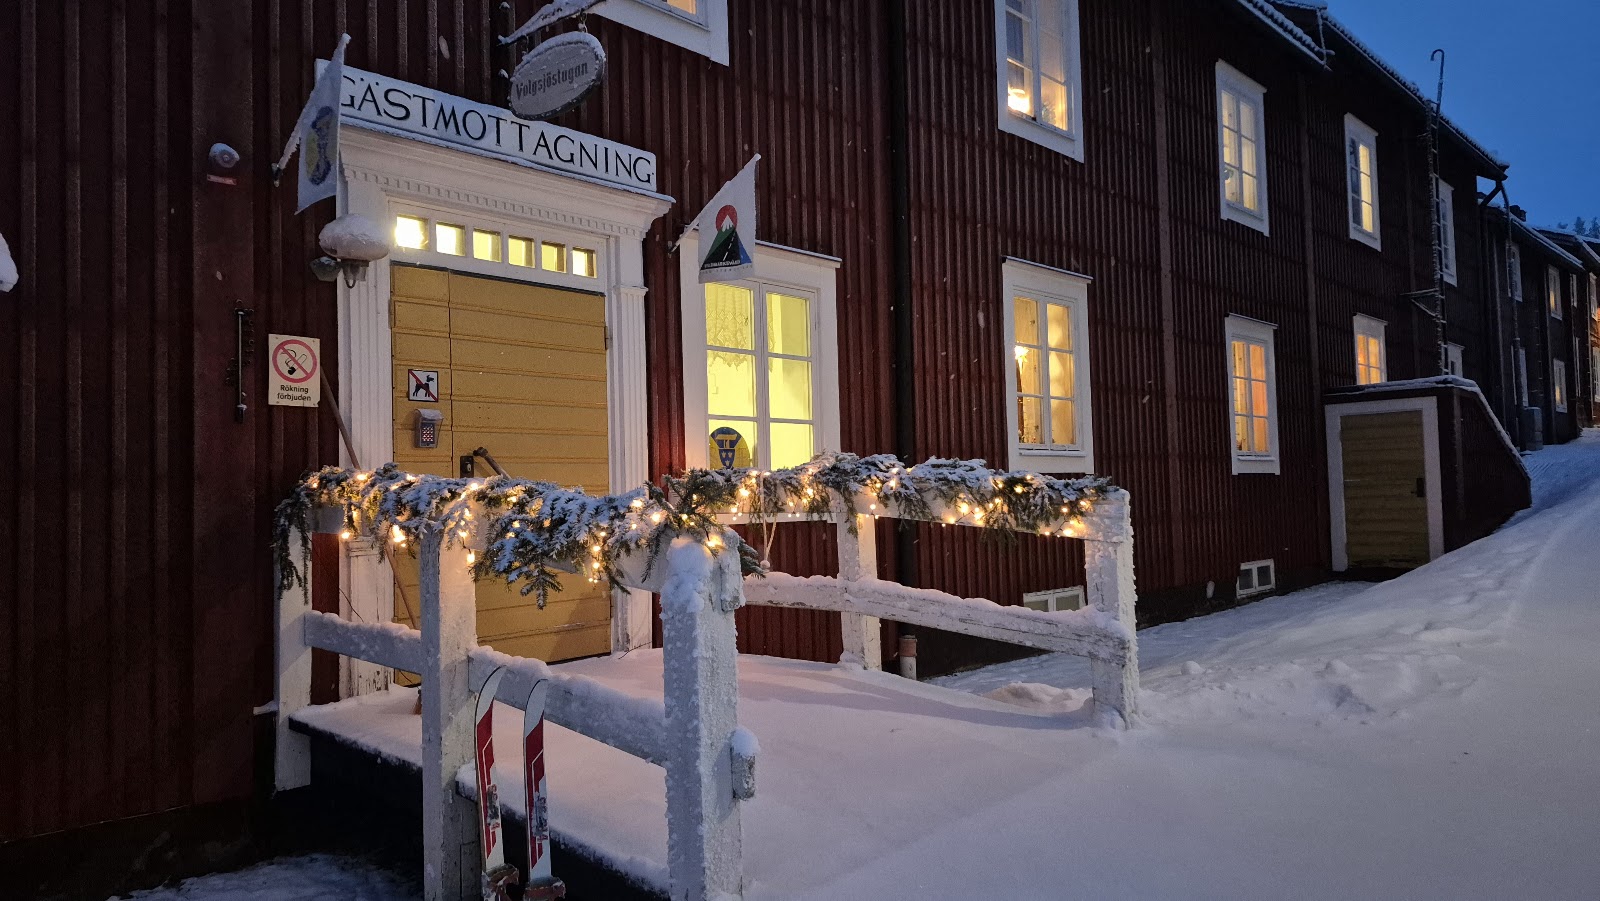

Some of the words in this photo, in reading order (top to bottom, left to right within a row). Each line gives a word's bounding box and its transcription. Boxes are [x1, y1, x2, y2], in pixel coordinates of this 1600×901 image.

[515, 62, 589, 100] Volgsjöstugan
[280, 384, 308, 394] Rökning
[277, 393, 311, 401] förbjuden
